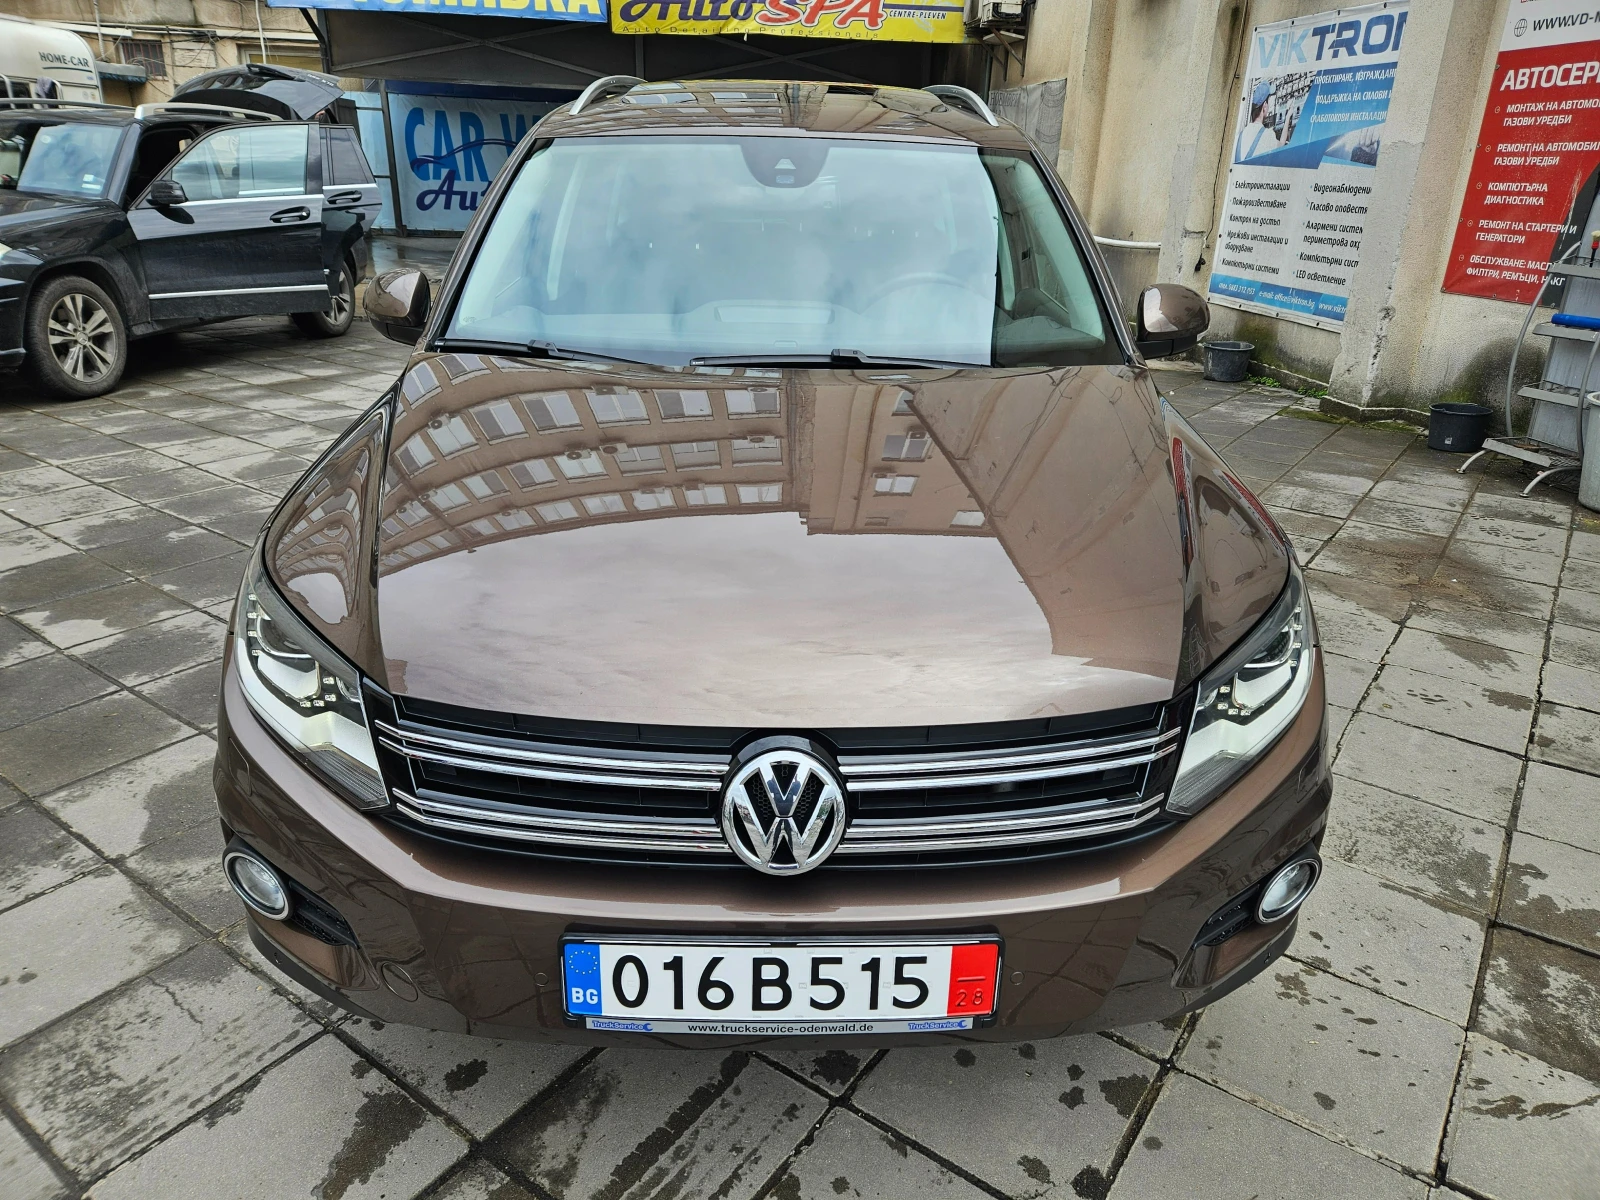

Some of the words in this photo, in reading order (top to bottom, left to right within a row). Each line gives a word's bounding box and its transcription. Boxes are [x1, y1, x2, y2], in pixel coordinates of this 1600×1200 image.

[889, 10, 947, 20] CENTRE-PLEVEN
[622, 26, 661, 34] Auto
[670, 27, 750, 35] Detailing
[759, 27, 879, 39] Professionals
[39, 51, 90, 68] HOME-CAR
[1500, 61, 1600, 91] АВТОСЕР
[1352, 91, 1361, 101] НА
[1362, 89, 1387, 100] СИЛОВИ
[1506, 102, 1545, 113] МОНТАЖ
[1546, 101, 1558, 112] НА
[1559, 98, 1600, 110] АВТОМО
[1503, 116, 1534, 126] ГАЗОВИ
[1535, 114, 1572, 127] УРЕДБИ
[405, 107, 490, 182] CAR
[1497, 143, 1531, 153] РЕМОНТ
[1532, 143, 1544, 152] НА
[1494, 156, 1524, 166] ГАЗОВИ
[1525, 156, 1560, 167] УРЕДБИ
[1488, 182, 1548, 192] КОМПЮТЪРНА
[1484, 195, 1544, 206] ДИАГНОСТИКА
[1310, 202, 1334, 212] Гласово
[1230, 214, 1252, 225] Контрол
[1306, 221, 1338, 232] Алармени
[1479, 219, 1511, 230] РЕМОНТ
[1512, 222, 1524, 231] НА
[1525, 222, 1568, 234] СТАРТЕРИ
[1569, 225, 1578, 235] И
[1303, 235, 1348, 247] периметрова
[1476, 232, 1525, 244] ГЕНЕРАТОРИ
[1300, 252, 1343, 266] Компютърни
[1470, 254, 1526, 268] ОБСЛУЖВАНЕ:
[1296, 270, 1306, 279] LED
[1307, 272, 1346, 285] осветление
[1466, 267, 1500, 279] ФИЛТРИ,
[1501, 271, 1539, 284] РЕМЪЦИ,
[571, 987, 598, 1004] BG
[955, 988, 984, 1007] 28
[592, 1020, 644, 1030] TruckService
[688, 1023, 874, 1033] www.truckservice-odenwald.de
[908, 1020, 958, 1030] TruckService
